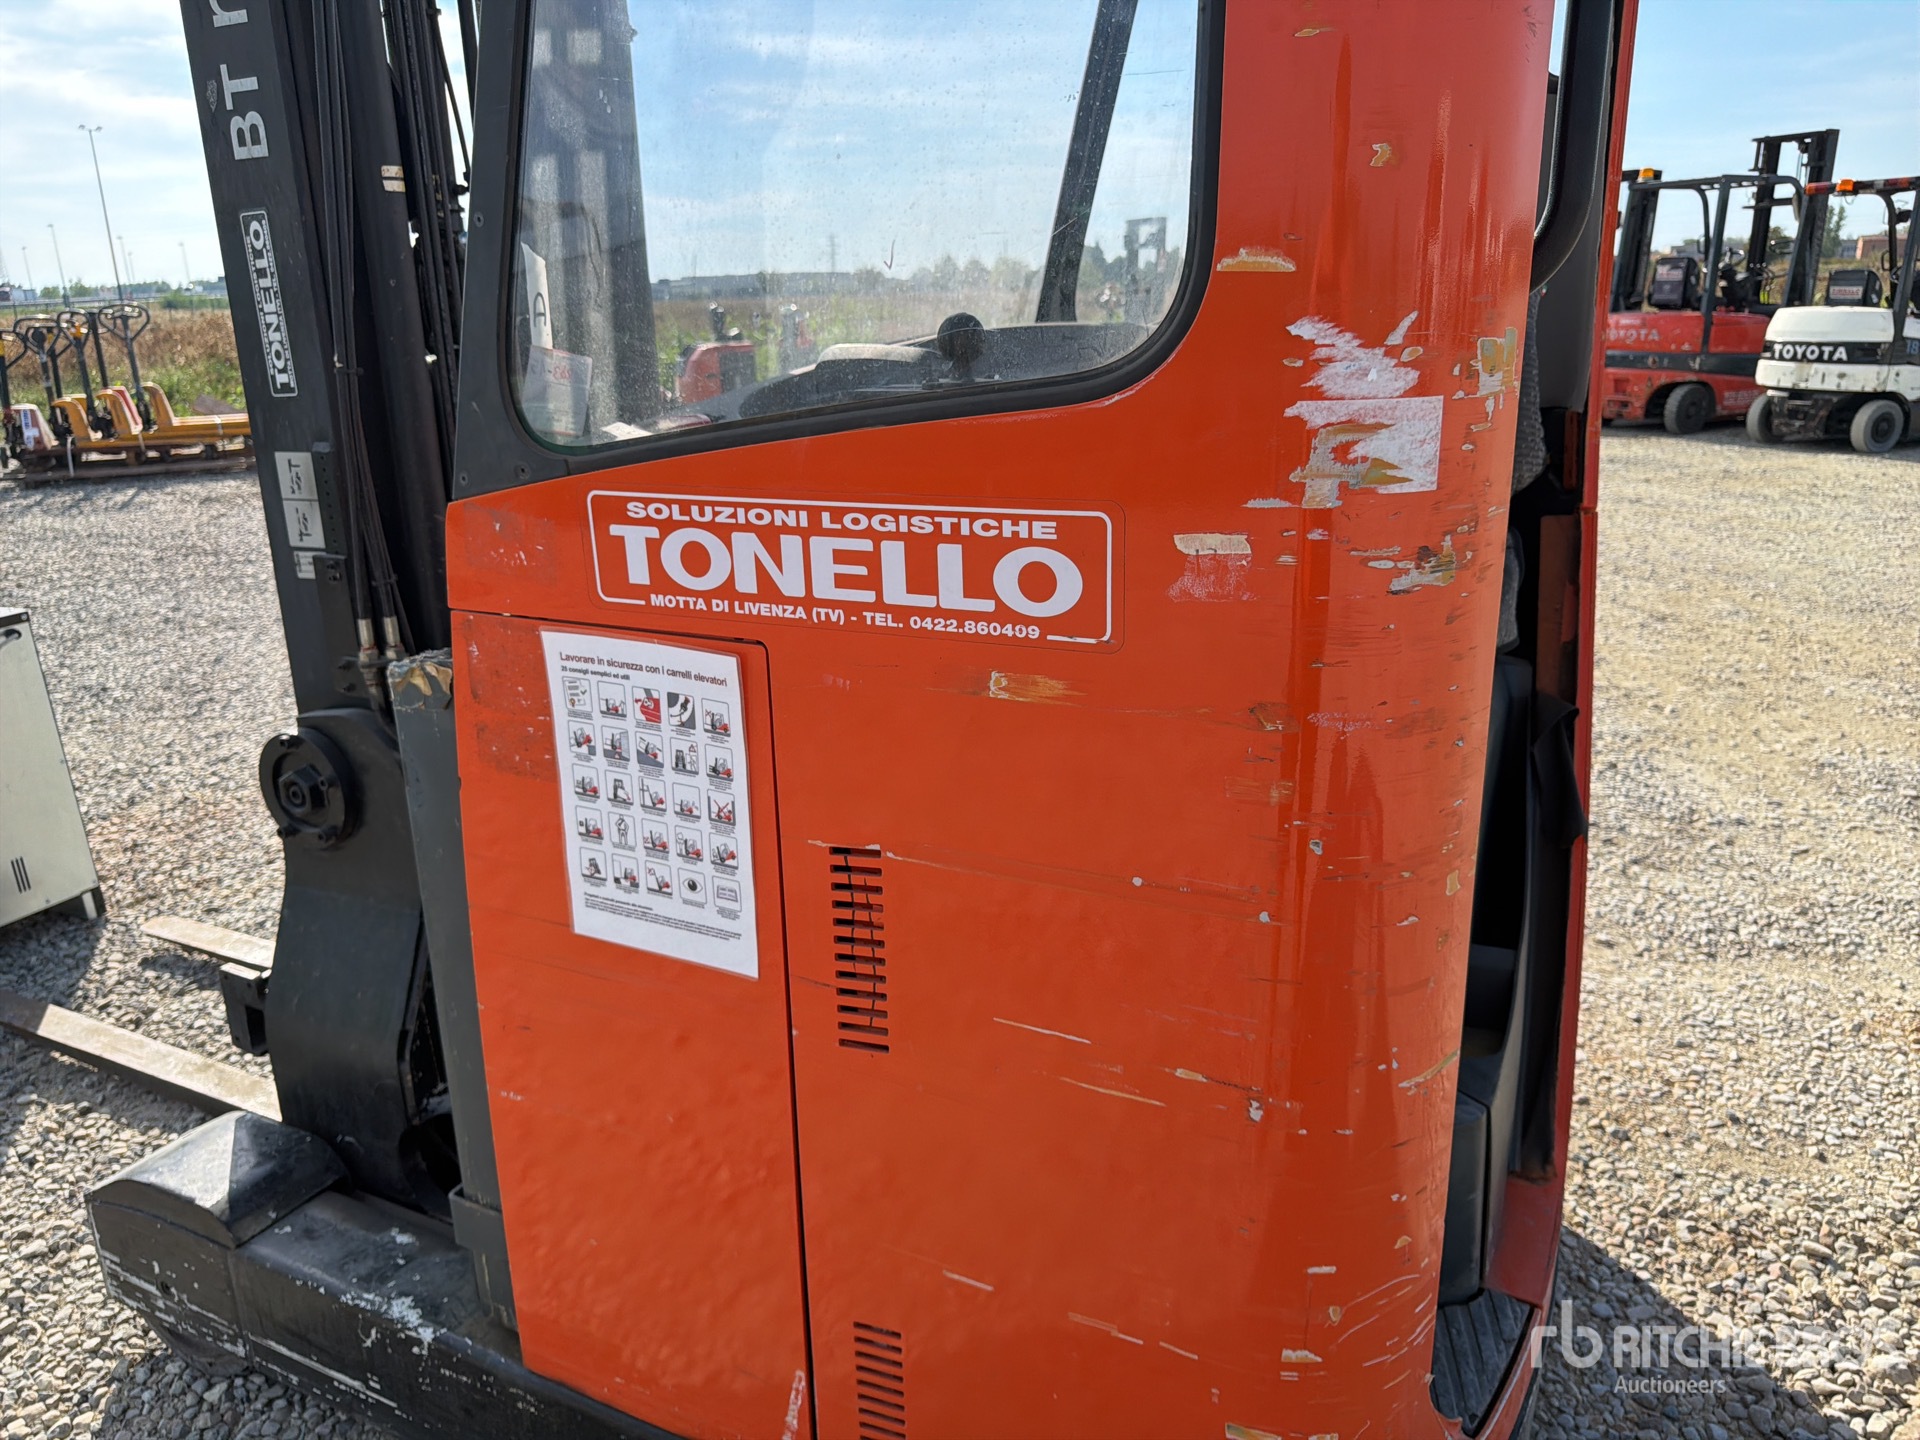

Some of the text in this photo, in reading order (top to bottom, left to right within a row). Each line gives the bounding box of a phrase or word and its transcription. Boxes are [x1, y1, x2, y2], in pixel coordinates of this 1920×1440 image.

[220, 64, 269, 161] BT
[249, 220, 290, 390] TONELLO
[1607, 328, 1661, 343] OYOTA
[1773, 343, 1848, 362] TOYOTA
[626, 501, 1058, 541] SOLUZIONI LOGISTICHE
[608, 523, 1085, 619] TONELLO
[650, 593, 707, 613] MOTTA
[711, 598, 729, 613] DI
[734, 599, 807, 620] LIVENZA
[811, 607, 845, 626] (TV)
[863, 612, 904, 629] TEL.
[909, 617, 1041, 640] 0422.860409
[559, 652, 596, 665] Lavorare
[596, 656, 605, 666] in
[606, 659, 644, 673] sicurezza
[644, 665, 661, 675] con
[666, 667, 693, 681] carrelli
[693, 672, 728, 688] elevatori
[568, 666, 590, 676] consigli
[590, 669, 612, 679] semplici
